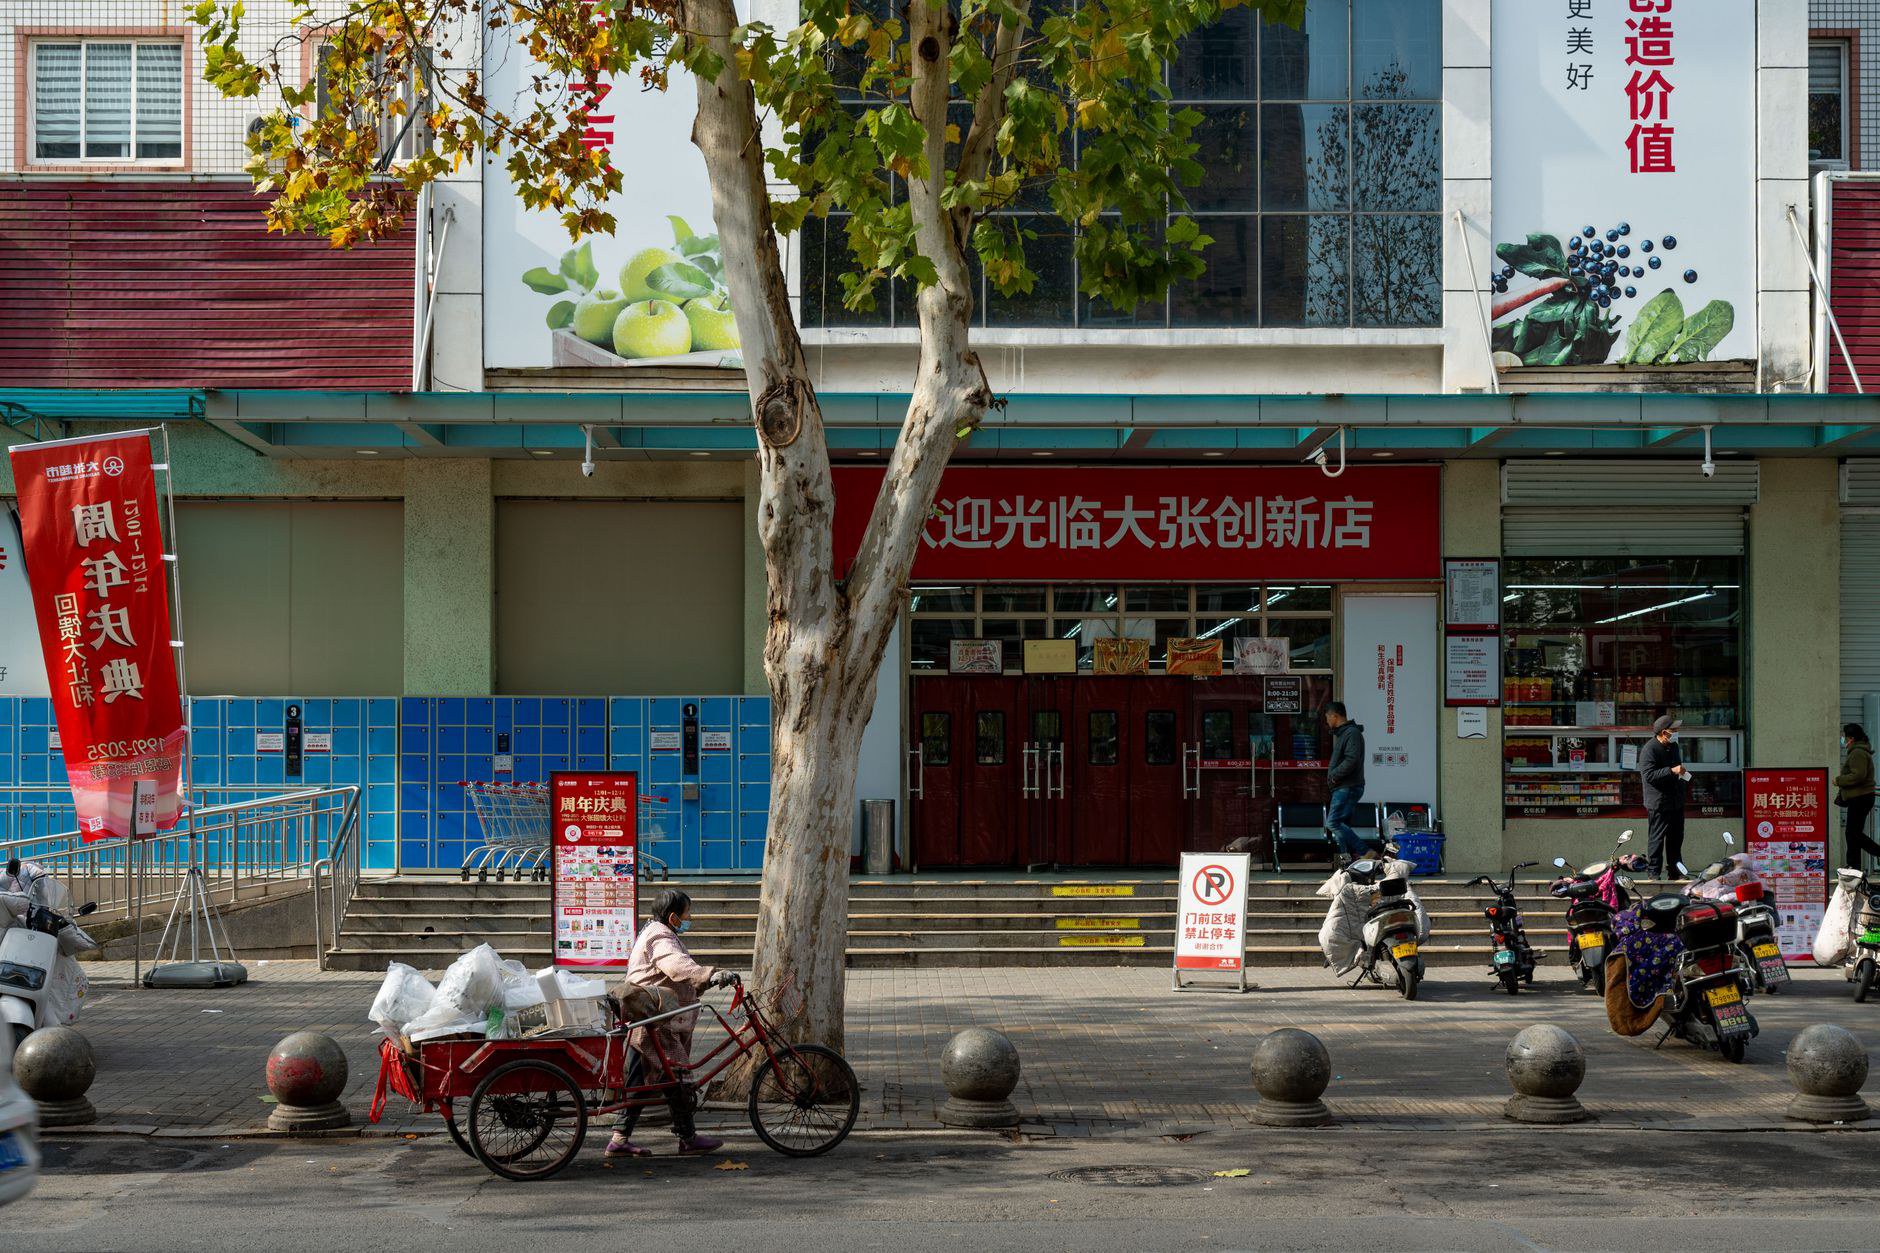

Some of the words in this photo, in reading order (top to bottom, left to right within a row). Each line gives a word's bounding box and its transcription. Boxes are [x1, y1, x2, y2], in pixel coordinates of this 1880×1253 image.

[1624, 0, 1676, 174] 造价值
[919, 495, 1374, 550] 迎光临大张创新店
[290, 706, 297, 716] 3
[688, 706, 693, 715] 1
[560, 796, 627, 813] 周年庆典
[1752, 792, 1818, 809] 周年庆典
[1185, 912, 1237, 926] 门前区域
[1184, 927, 1236, 940] 禁止停车
